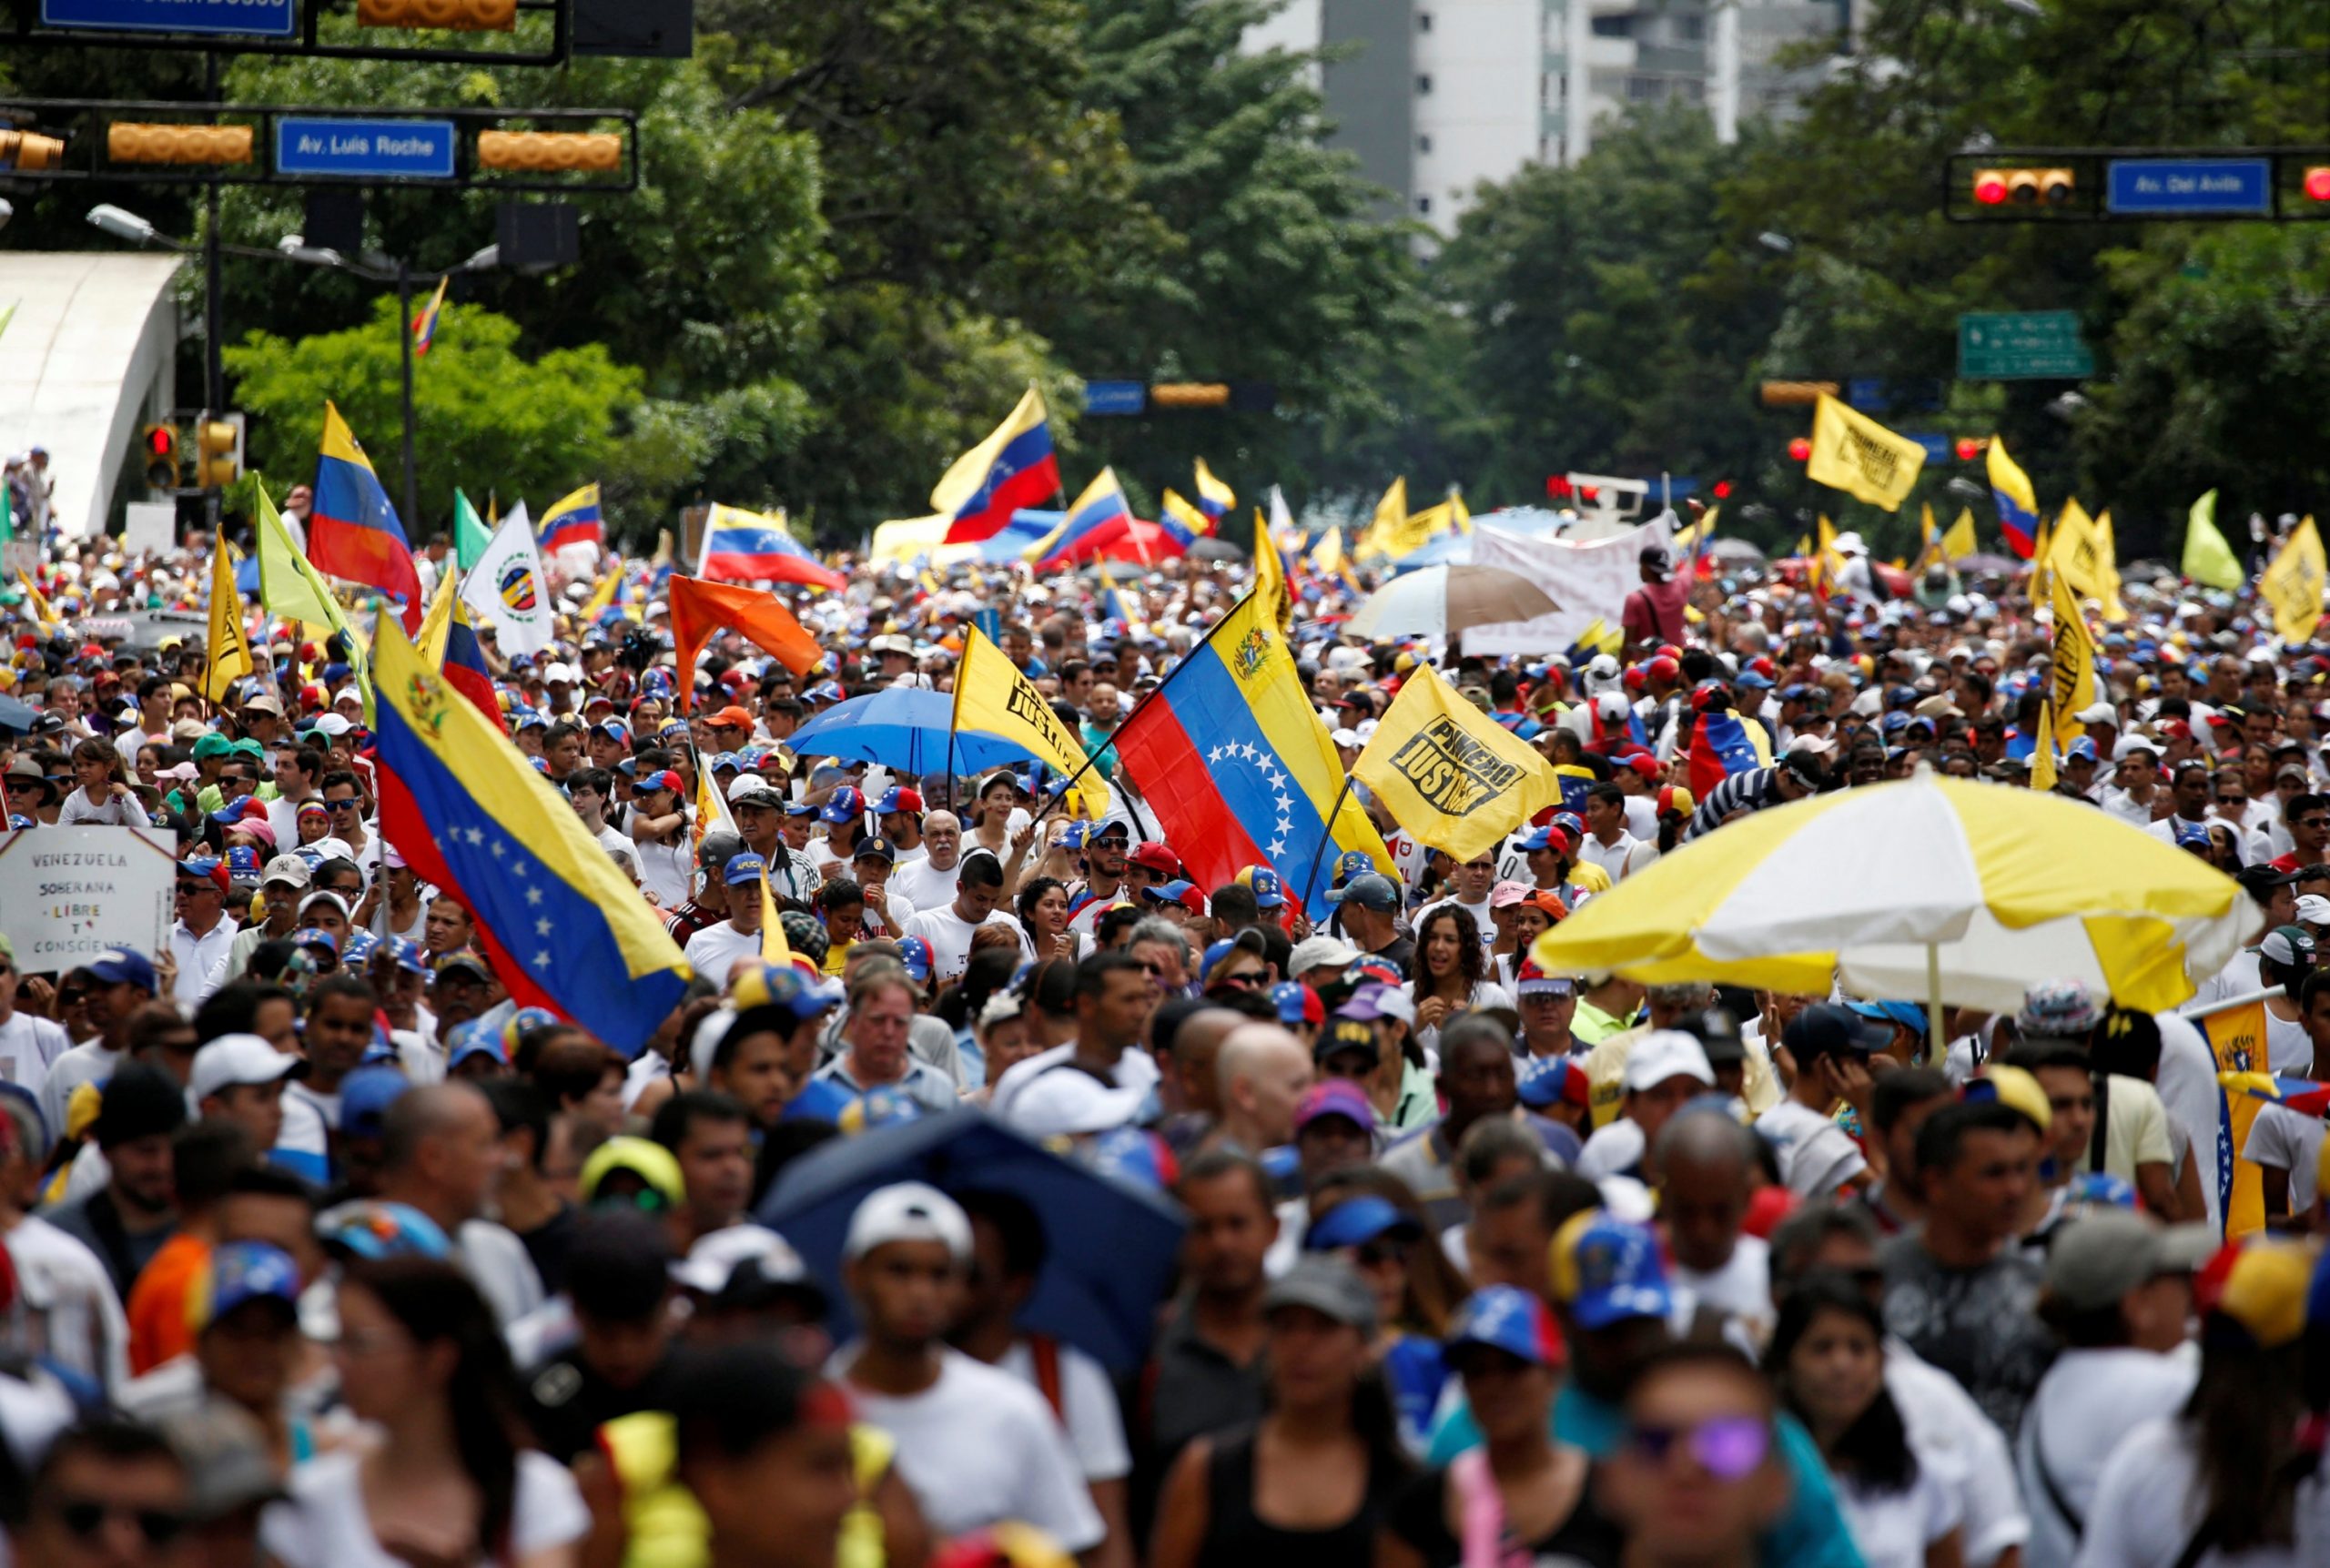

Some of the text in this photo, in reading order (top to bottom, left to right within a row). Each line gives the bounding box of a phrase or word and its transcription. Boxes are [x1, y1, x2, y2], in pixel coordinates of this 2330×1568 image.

[297, 135, 434, 157] Av. Luis Roche
[32, 853, 127, 867] VENEZUELA
[39, 881, 116, 896] SOBERANA
[34, 936, 132, 954] CONSCIEN
